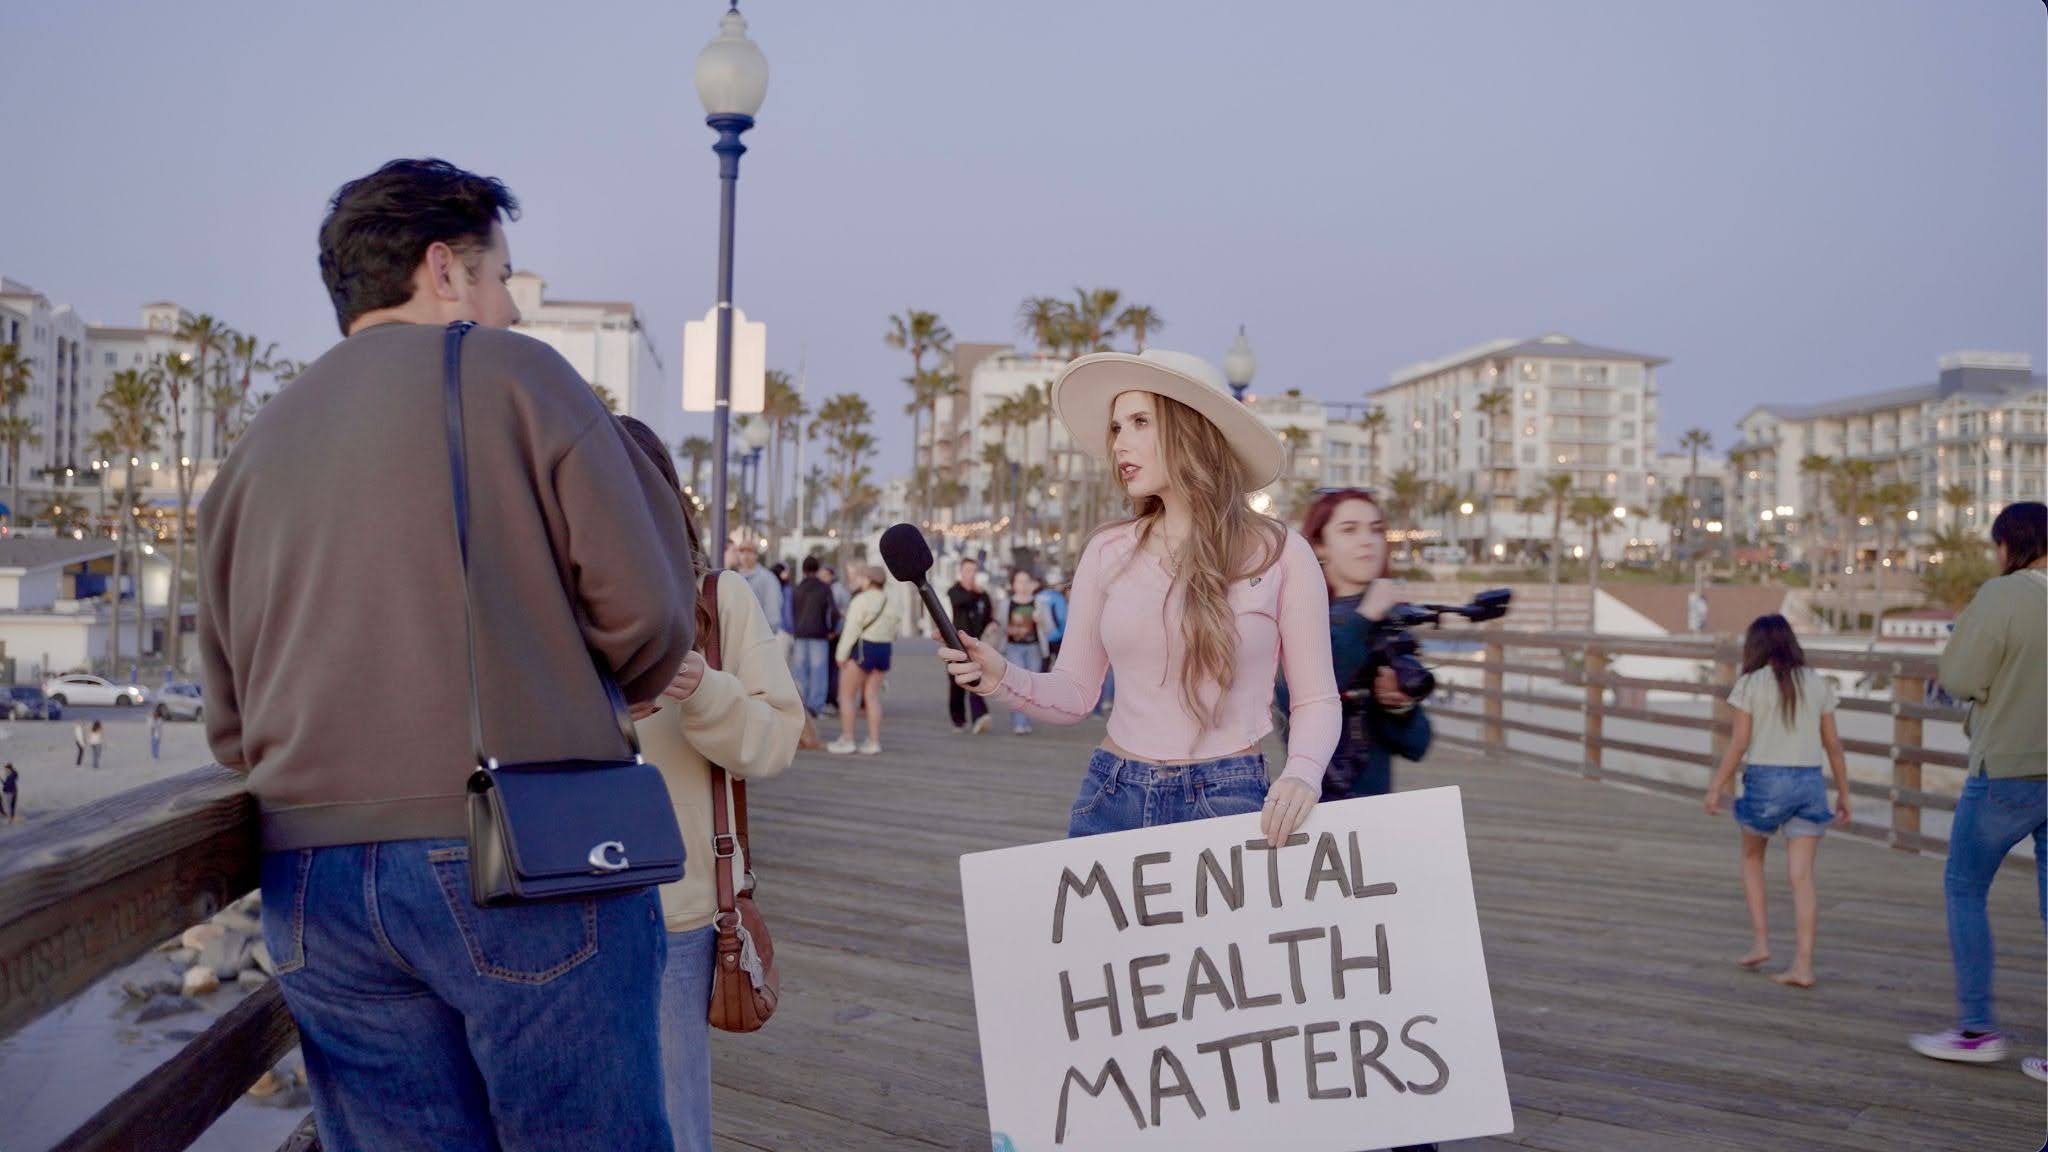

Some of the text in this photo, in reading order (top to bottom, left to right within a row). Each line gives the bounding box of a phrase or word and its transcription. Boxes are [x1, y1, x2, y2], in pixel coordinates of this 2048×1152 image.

[588, 840, 629, 870] C
[1052, 831, 1397, 944] MENTAL
[1059, 924, 1392, 1042] HEALTH
[1055, 1015, 1450, 1145] MATTERS
